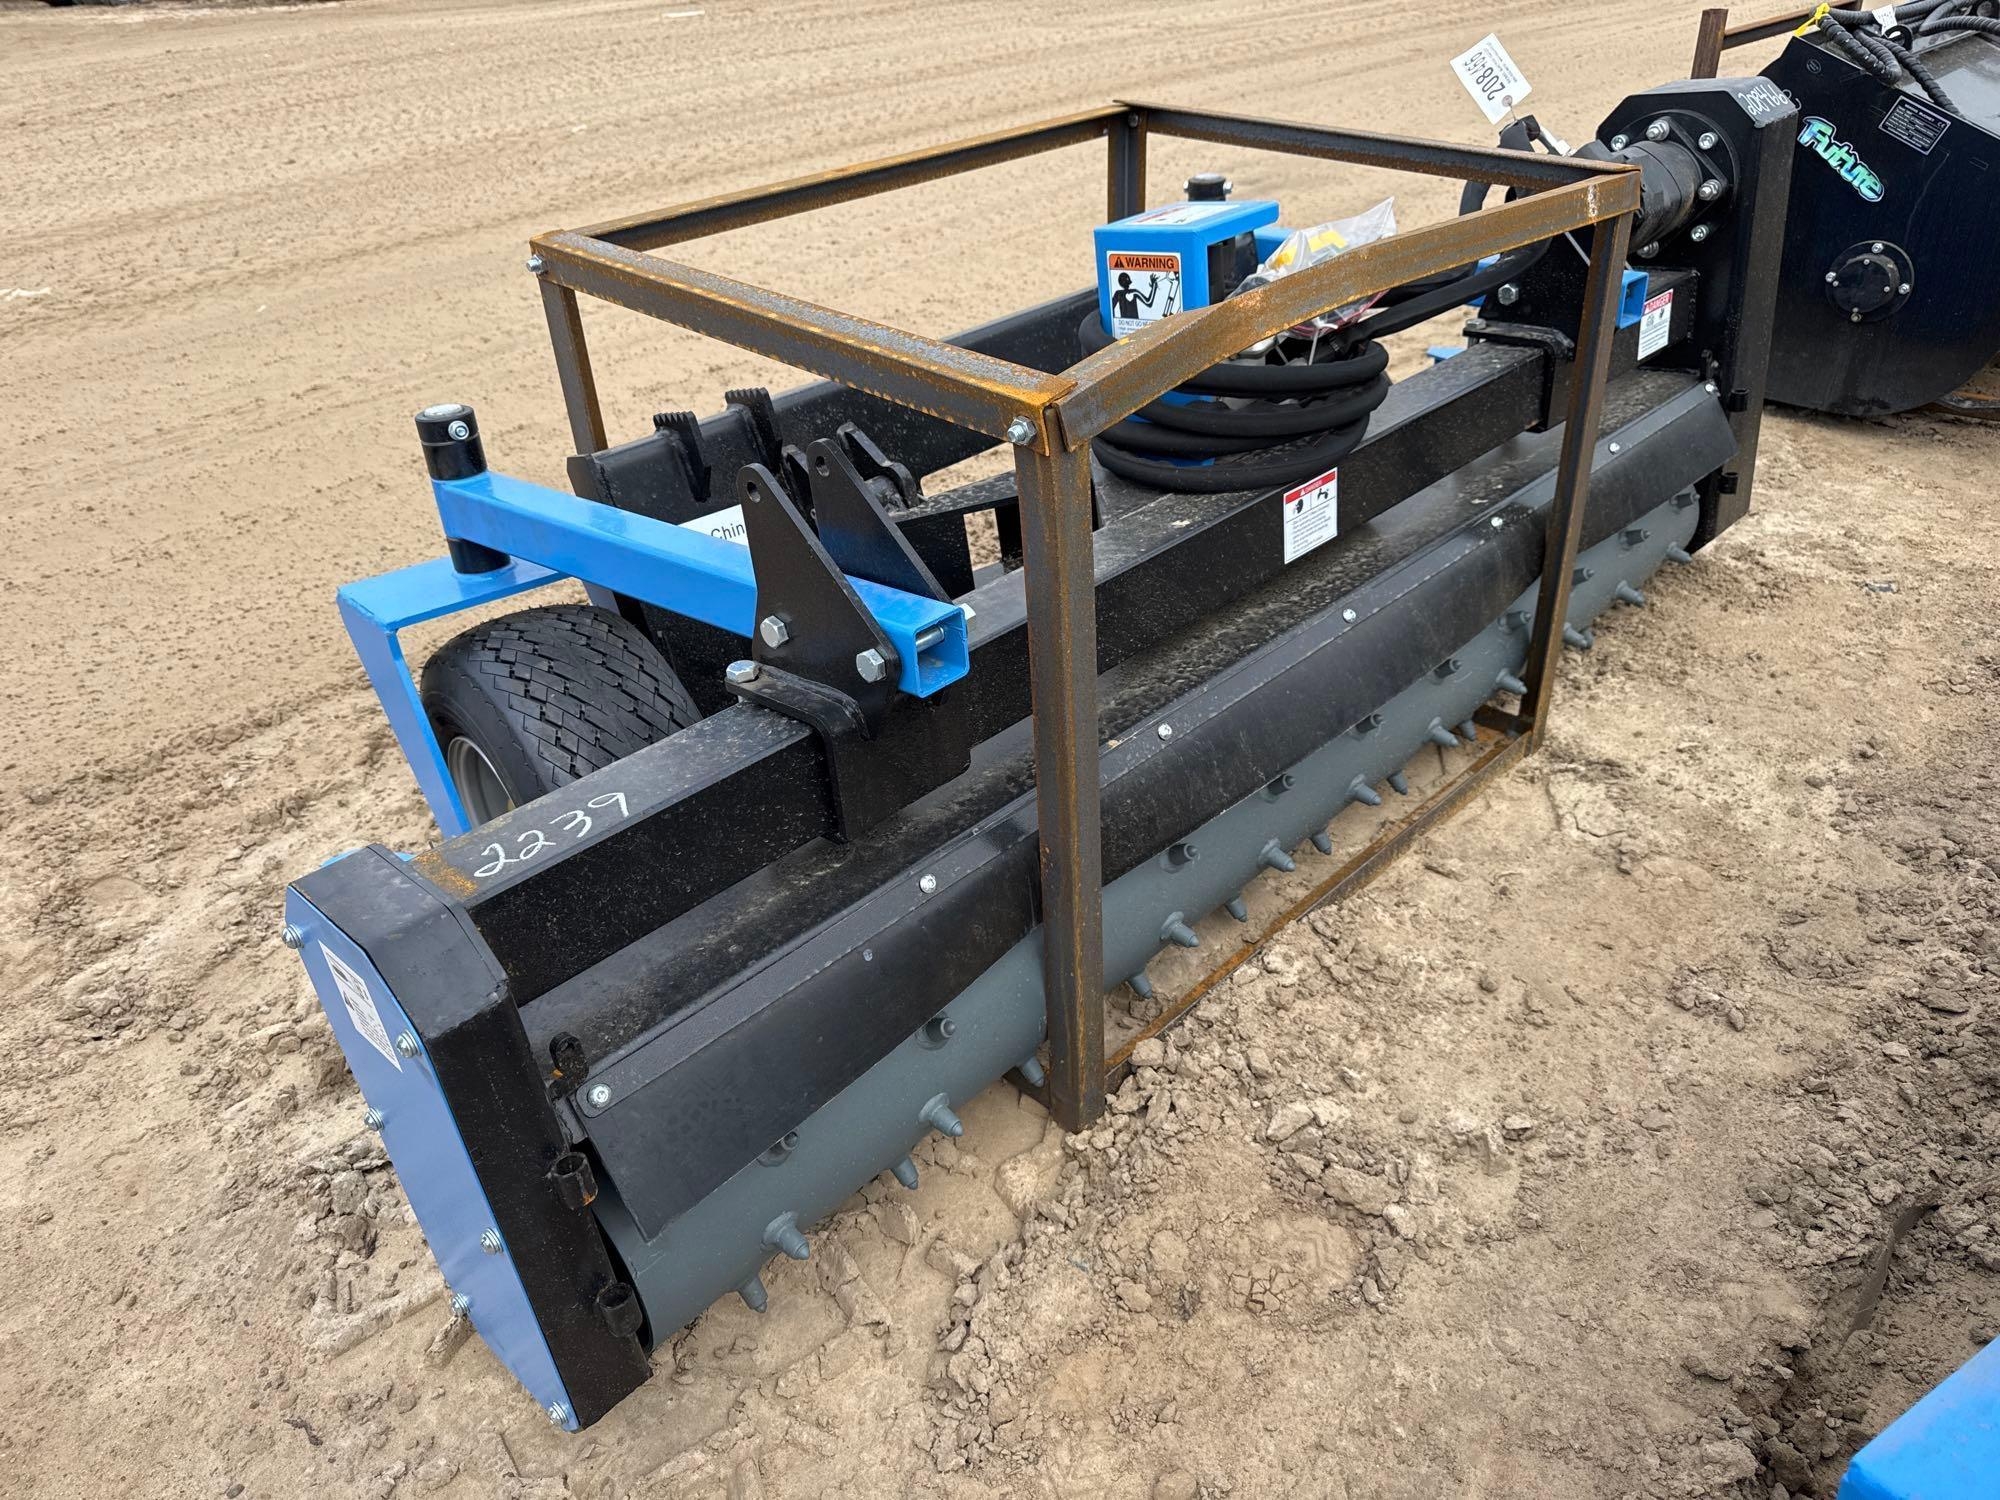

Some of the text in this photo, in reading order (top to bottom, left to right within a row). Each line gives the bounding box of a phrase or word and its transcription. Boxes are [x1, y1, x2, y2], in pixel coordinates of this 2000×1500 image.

[1464, 51, 1506, 101] 208466
[1800, 118, 1882, 200] Future
[1125, 257, 1174, 269] WARNING
[711, 523, 745, 540] Chin
[474, 792, 629, 877] 2239
